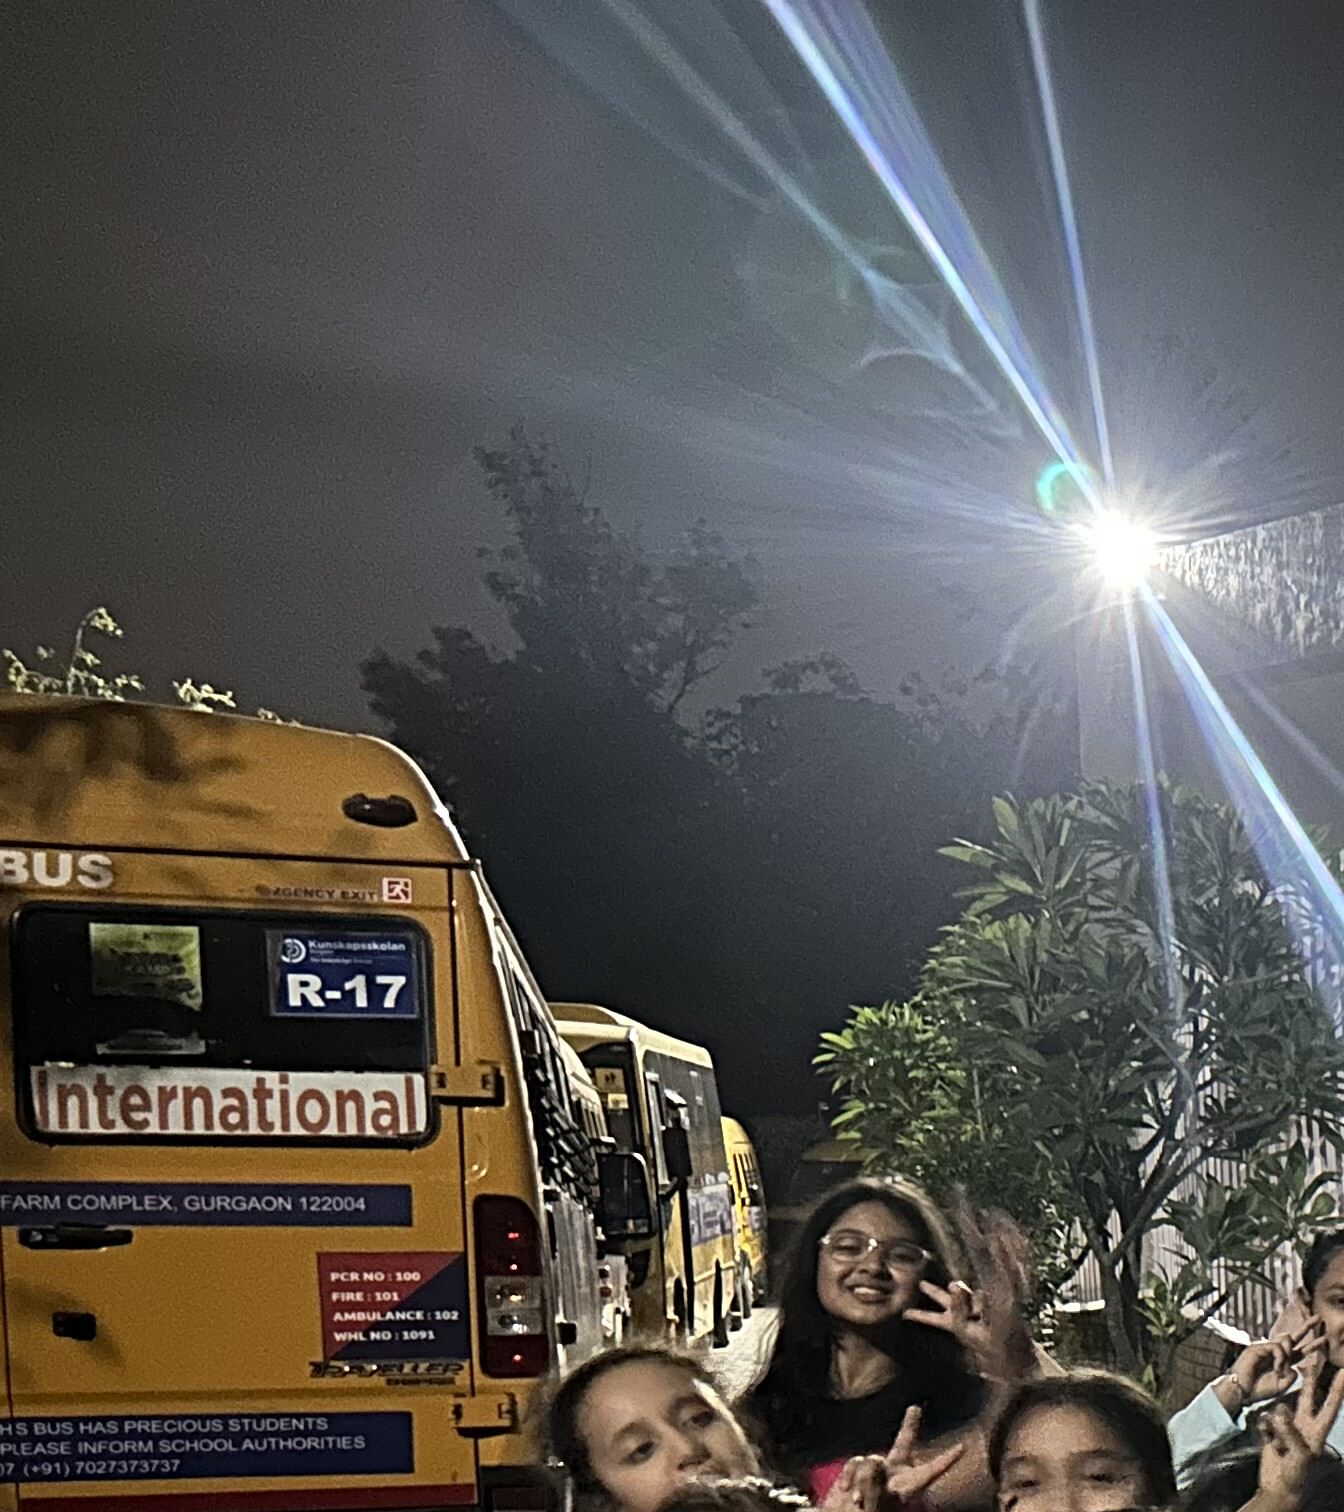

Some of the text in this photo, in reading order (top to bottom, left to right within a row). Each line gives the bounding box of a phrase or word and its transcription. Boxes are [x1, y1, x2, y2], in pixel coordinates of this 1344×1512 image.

[0, 849, 113, 889] BUS
[287, 973, 407, 1008] R-17
[37, 1071, 418, 1138] International
[0, 1195, 366, 1212] FARM COMPLEX, GURGAON 122004
[330, 1272, 360, 1282] PCR
[363, 1272, 385, 1281] NO
[395, 1272, 421, 1282] 100
[331, 1292, 364, 1302] FIRE
[375, 1291, 400, 1301] 101
[333, 1311, 425, 1322] AMBULANCE
[434, 1310, 459, 1321] 102
[334, 1331, 367, 1341] WHL
[370, 1330, 392, 1341] NO
[402, 1330, 435, 1341] 1091
[33, 1422, 73, 1435] BUS
[79, 1421, 119, 1434] HAS
[124, 1419, 223, 1434] PRECIOUS
[228, 1417, 329, 1432] STUDENTS
[0, 1435, 366, 1456] PLEASE INFORM SCHOOL AUTHORITIES
[23, 1462, 70, 1477] (+91)
[75, 1459, 181, 1475] 7027373737
